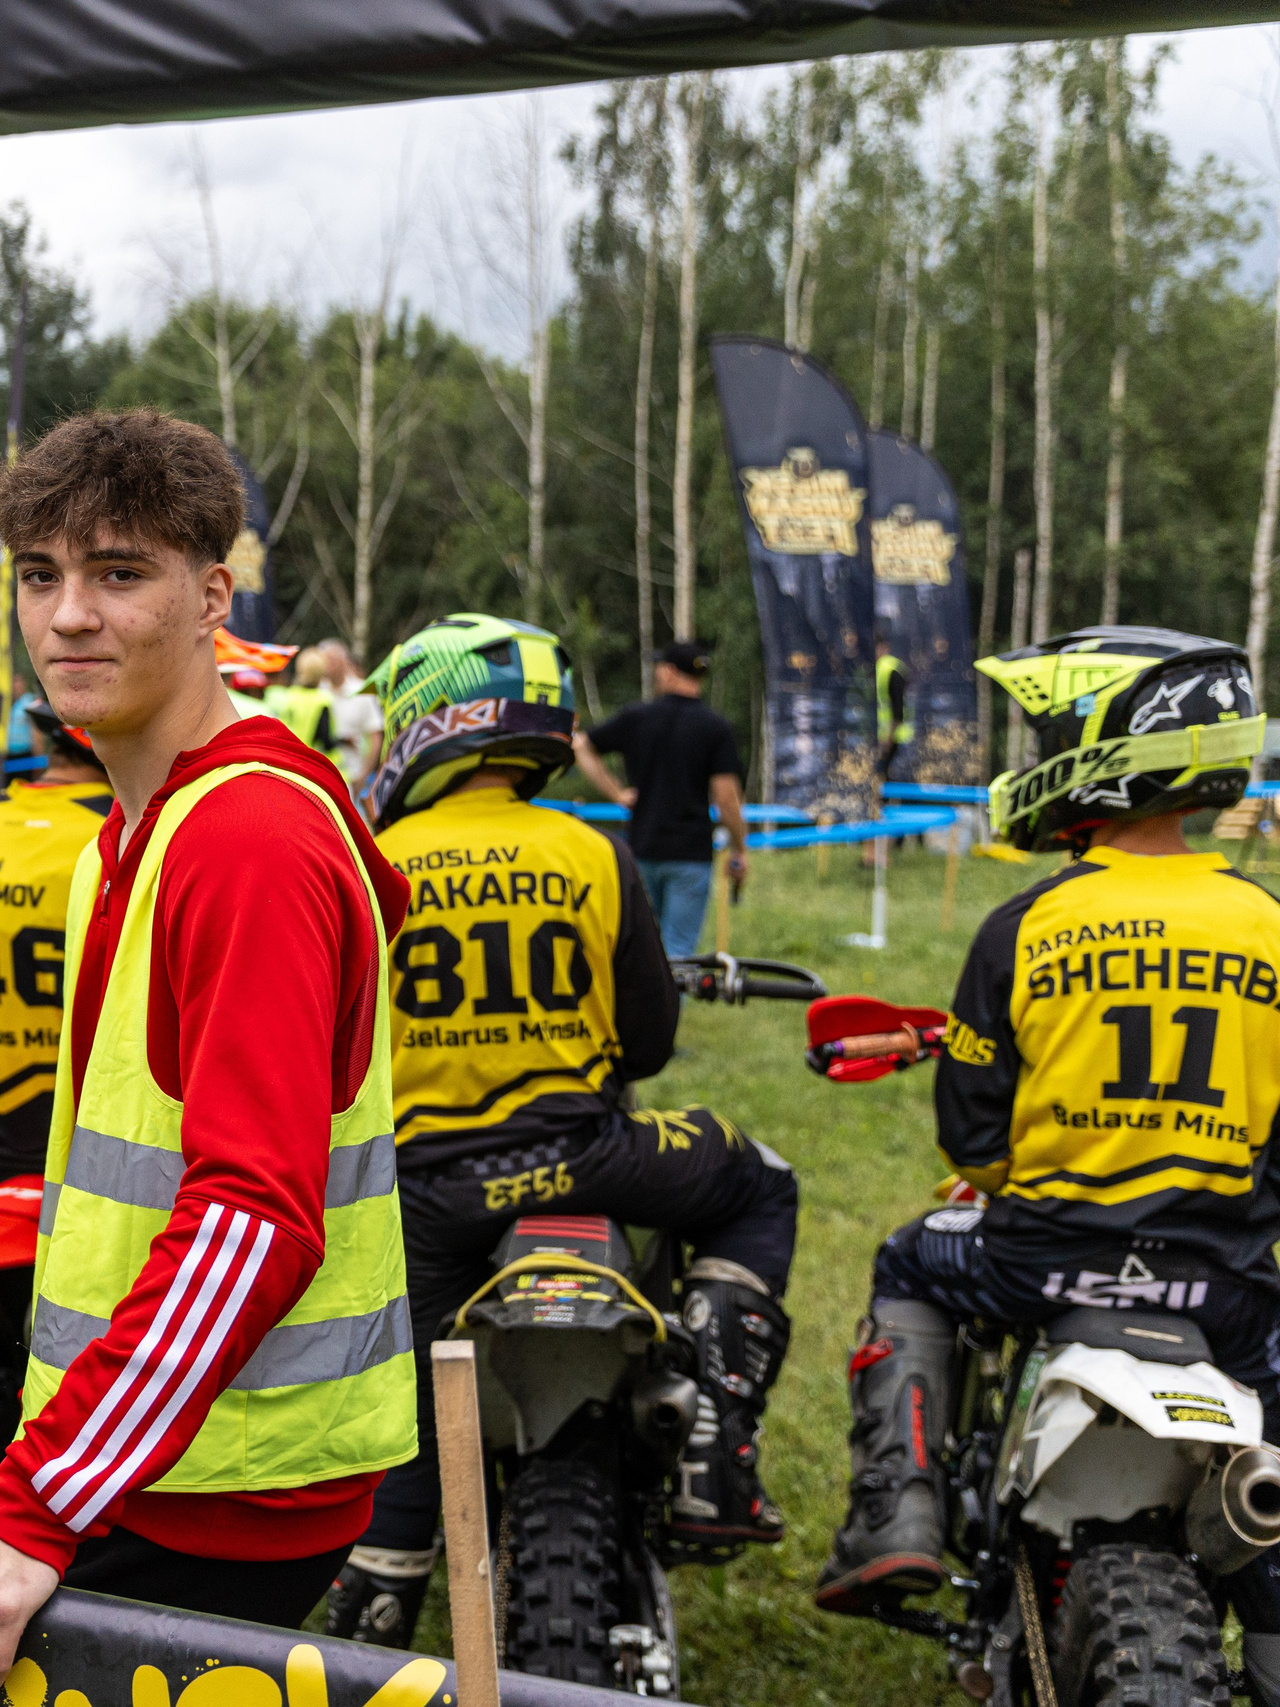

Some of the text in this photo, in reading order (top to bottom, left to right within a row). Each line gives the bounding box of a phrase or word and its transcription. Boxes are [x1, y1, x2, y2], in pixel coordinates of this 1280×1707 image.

[1006, 741, 1129, 817] 100%
[407, 871, 591, 917] AKAROV
[394, 919, 592, 1019] 810
[1025, 920, 1166, 964] JARAMIR
[1027, 949, 1280, 1013] SHCHERB
[402, 1019, 592, 1048] Belarus Minsk
[1101, 1004, 1225, 1109] 11
